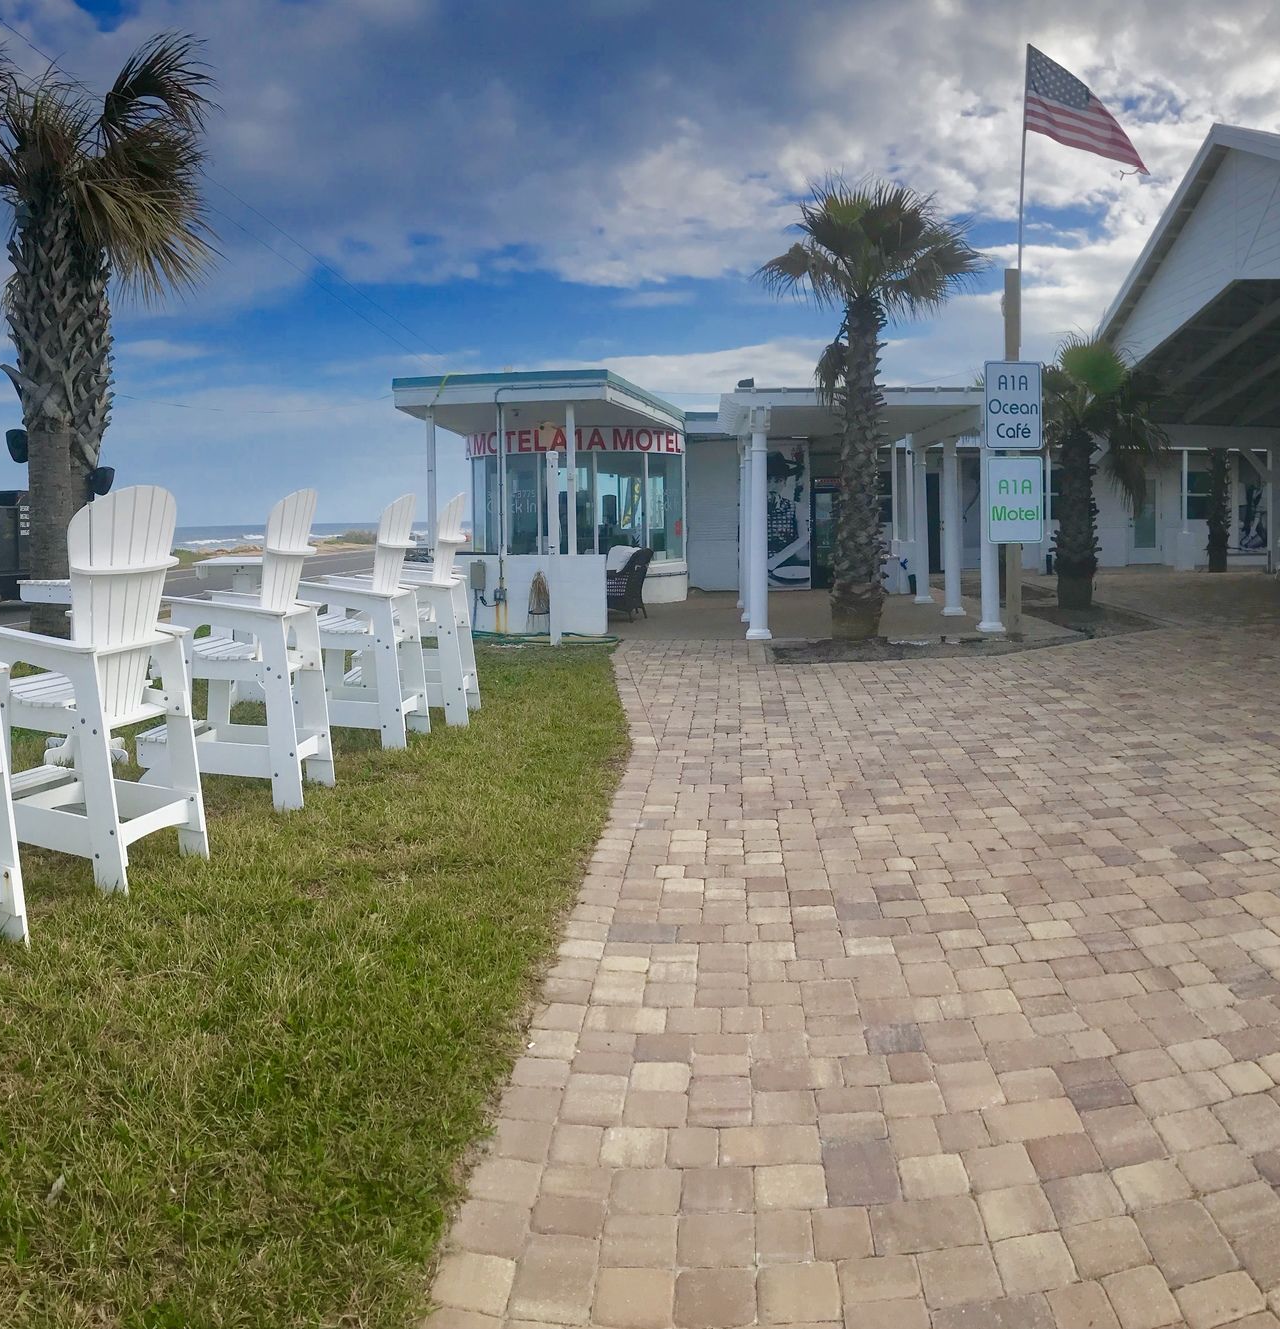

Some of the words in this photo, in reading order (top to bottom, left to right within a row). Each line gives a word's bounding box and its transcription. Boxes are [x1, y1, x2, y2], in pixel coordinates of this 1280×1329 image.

[998, 375, 1028, 390] A1A
[989, 399, 1038, 415] Ocean
[996, 423, 1031, 438] Café
[474, 430, 546, 455] MOTEL
[612, 428, 681, 453] MOTEL
[998, 479, 1032, 495] A1A
[992, 506, 1039, 521] Motel
